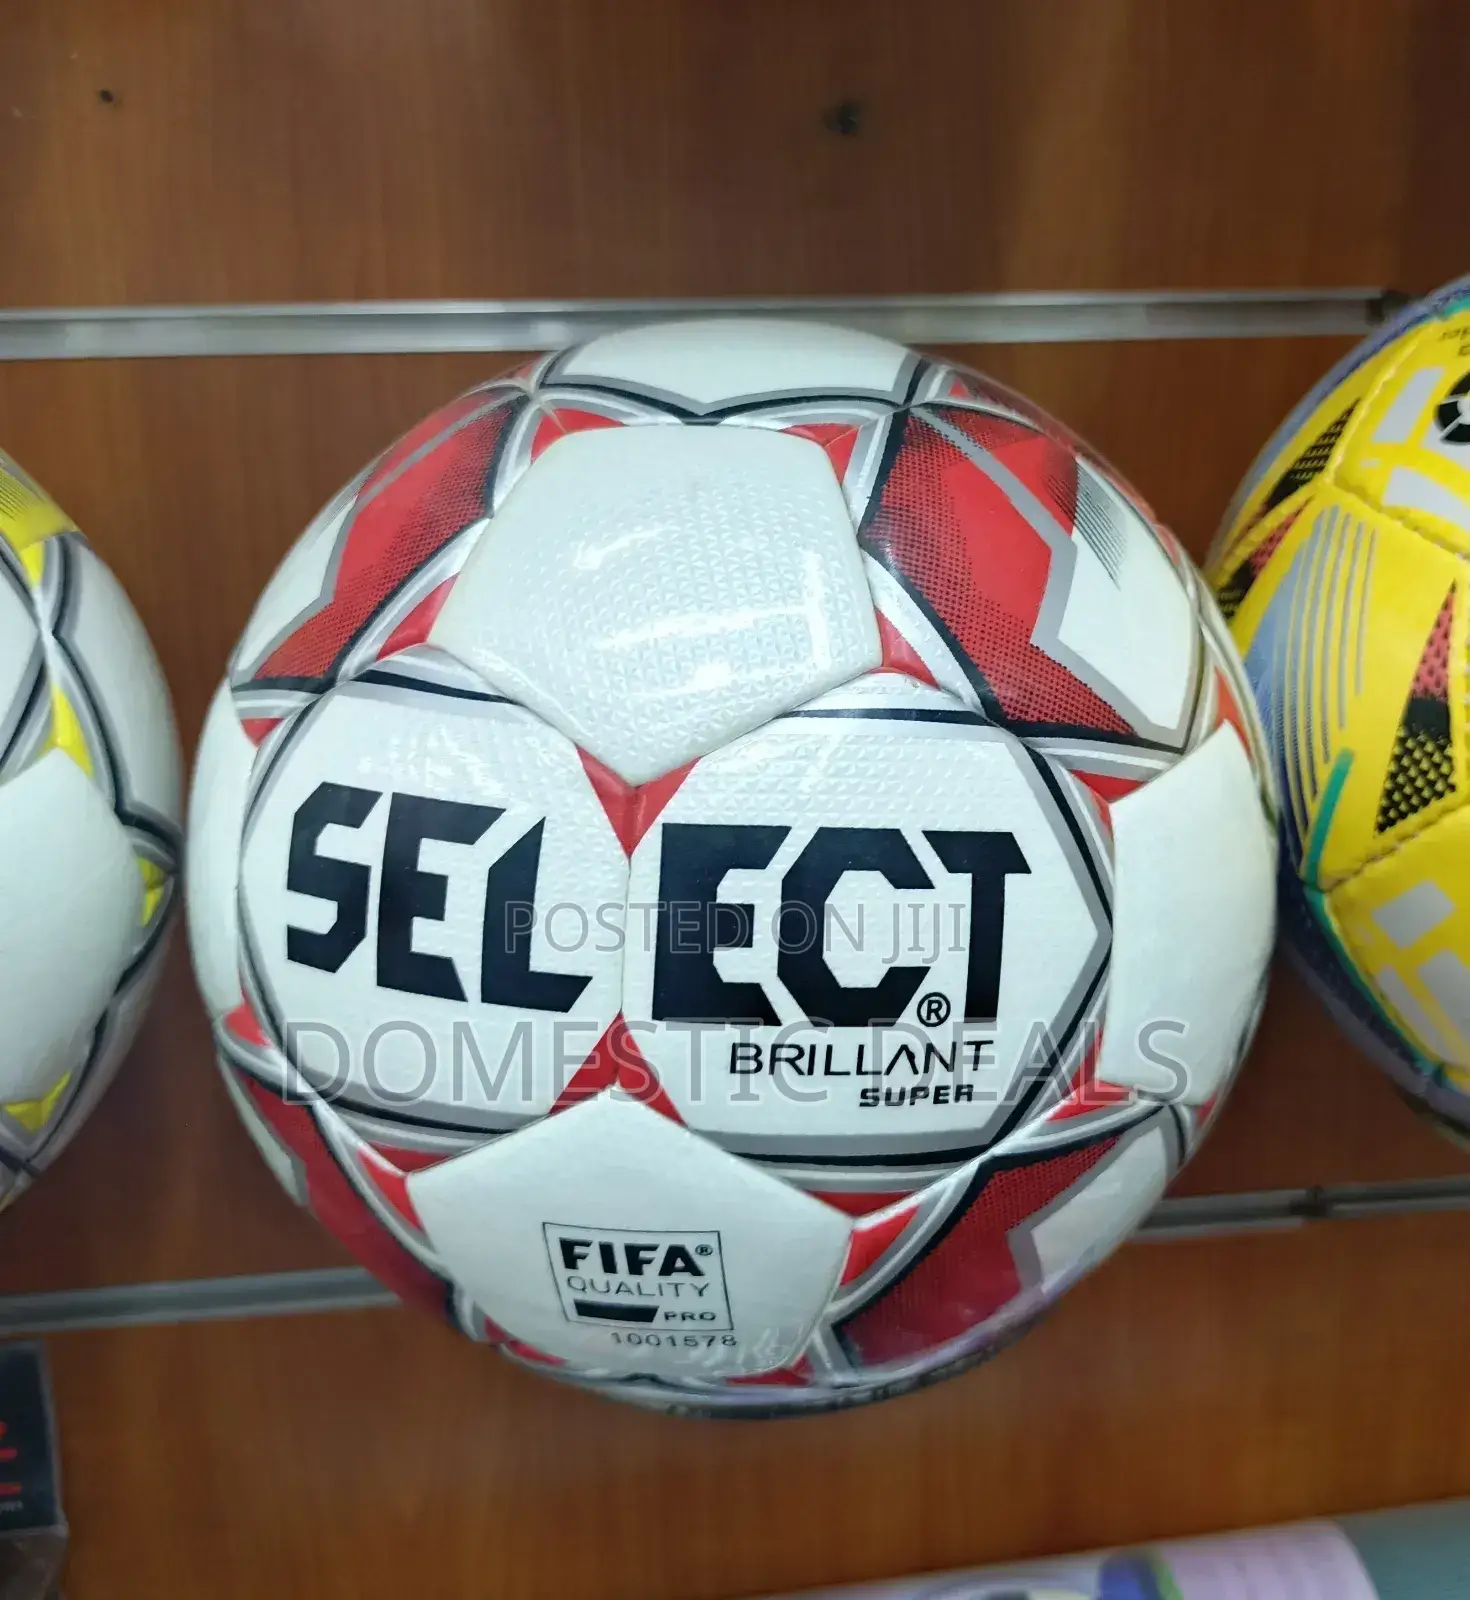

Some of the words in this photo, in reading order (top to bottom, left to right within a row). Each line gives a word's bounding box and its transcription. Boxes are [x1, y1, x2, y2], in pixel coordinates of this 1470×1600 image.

[729, 1039, 994, 1077] BRILLANT
[858, 1084, 974, 1107] SUPER
[566, 1275, 711, 1298] QUALITY
[663, 1310, 717, 1322] PRO
[611, 1331, 738, 1348] 1001578
